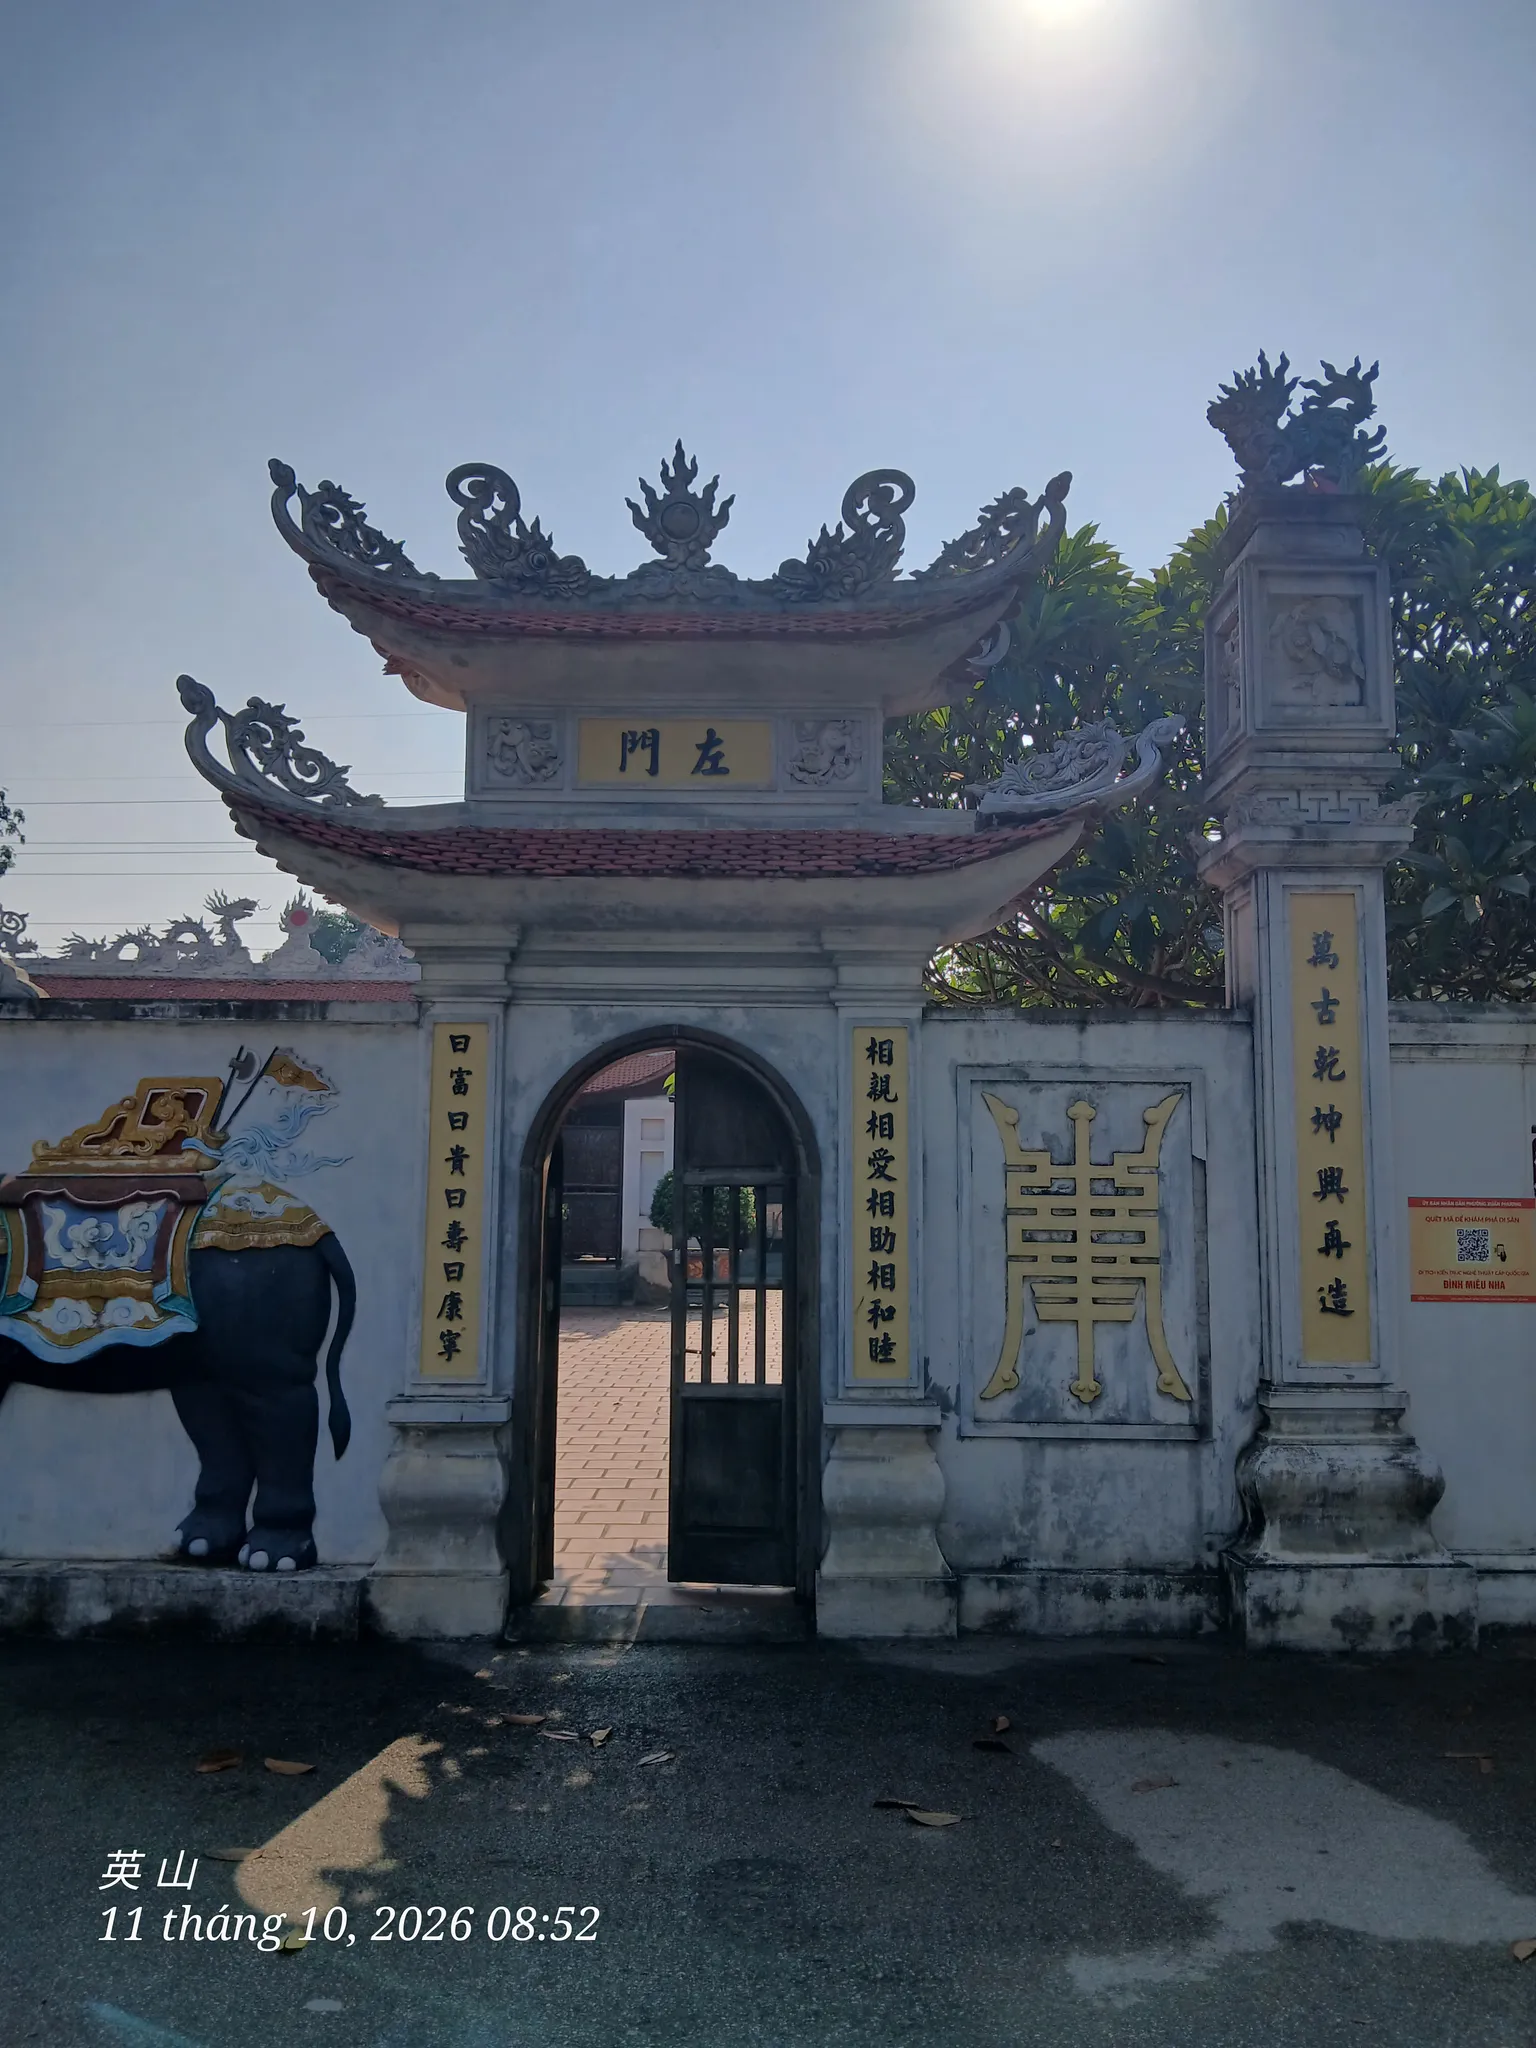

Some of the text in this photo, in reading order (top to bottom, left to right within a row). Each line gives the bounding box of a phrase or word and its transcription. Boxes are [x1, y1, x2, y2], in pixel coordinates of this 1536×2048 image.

[865, 1036, 899, 1364] 相親相愛相助相和睦
[1443, 1278, 1463, 1289] ĐÌNH
[1488, 1280, 1506, 1290] NHA
